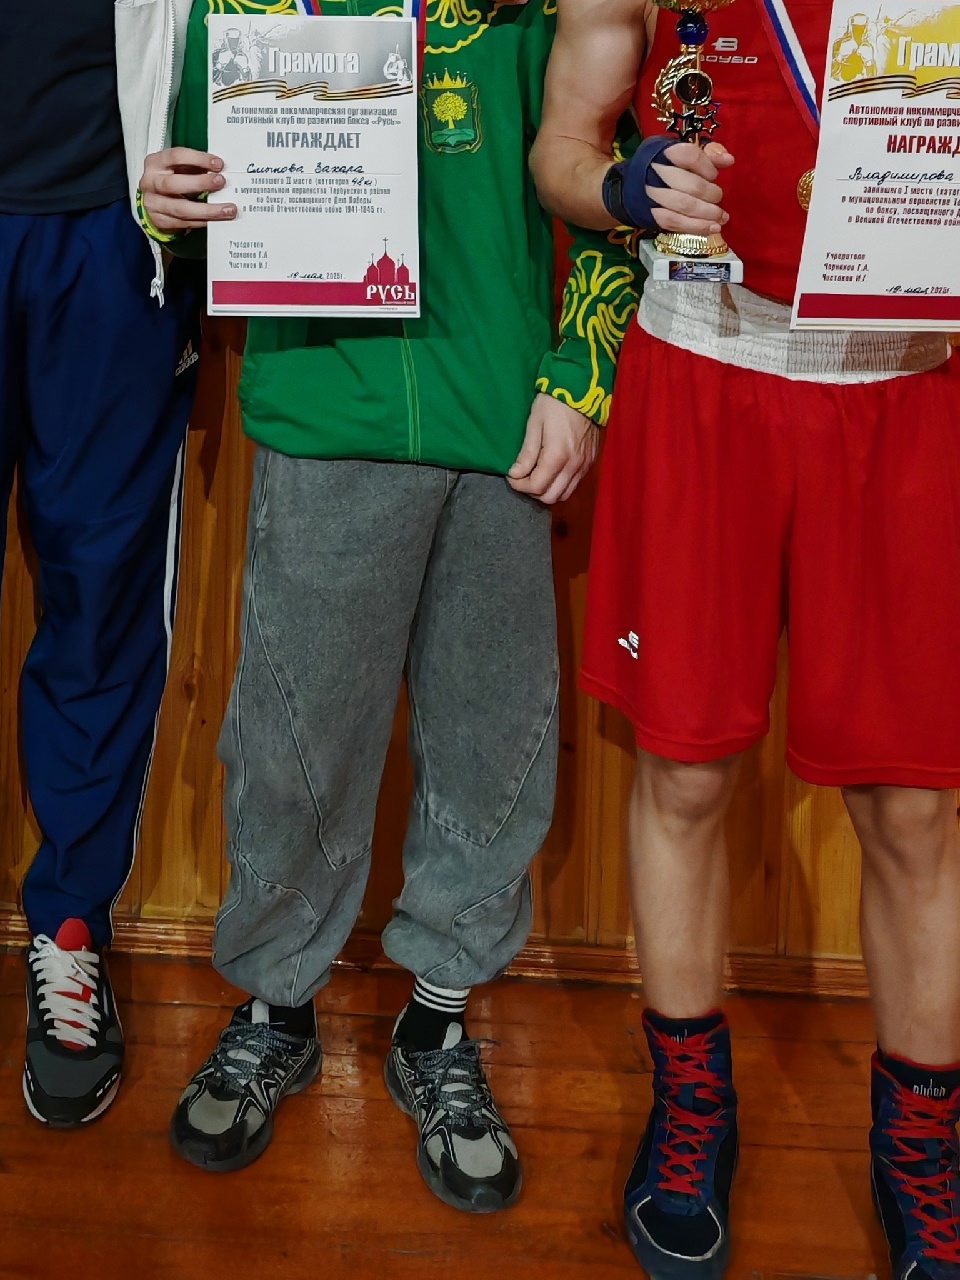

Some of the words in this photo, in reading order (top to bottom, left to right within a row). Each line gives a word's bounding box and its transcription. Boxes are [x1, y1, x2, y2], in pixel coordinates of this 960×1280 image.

[268, 48, 360, 76] Грамота
[897, 36, 960, 71] Грам
[226, 115, 274, 124] спортивный
[275, 115, 295, 125] клуб
[843, 116, 898, 127] спортивный
[900, 116, 922, 128] клуб
[266, 131, 361, 151] НАГРАЖДАЕТ
